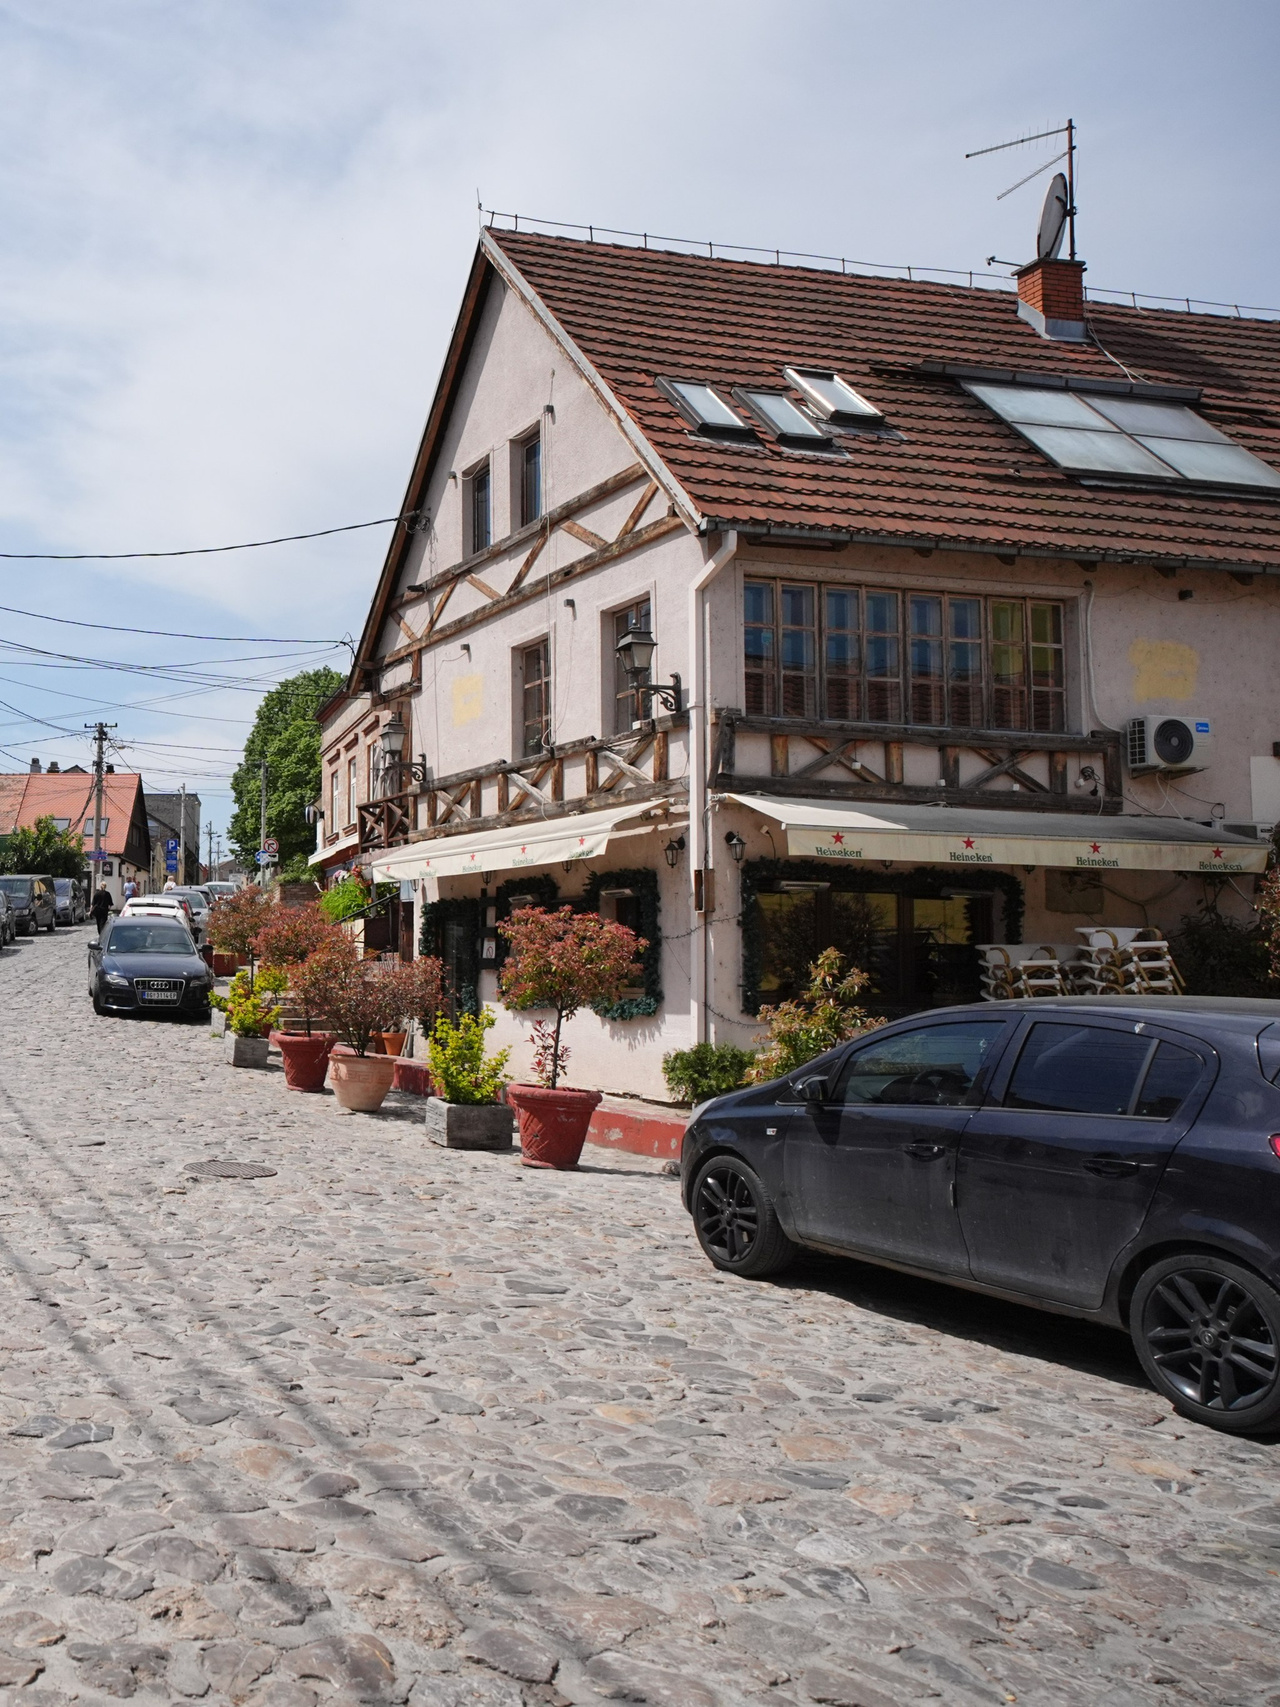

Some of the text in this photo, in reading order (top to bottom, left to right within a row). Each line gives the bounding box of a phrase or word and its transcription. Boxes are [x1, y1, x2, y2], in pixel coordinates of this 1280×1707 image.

[168, 840, 176, 850] P
[815, 846, 862, 858] Heineken
[949, 852, 992, 863] Heineken
[1076, 856, 1119, 867] Heineken
[1199, 861, 1242, 871] Heineken
